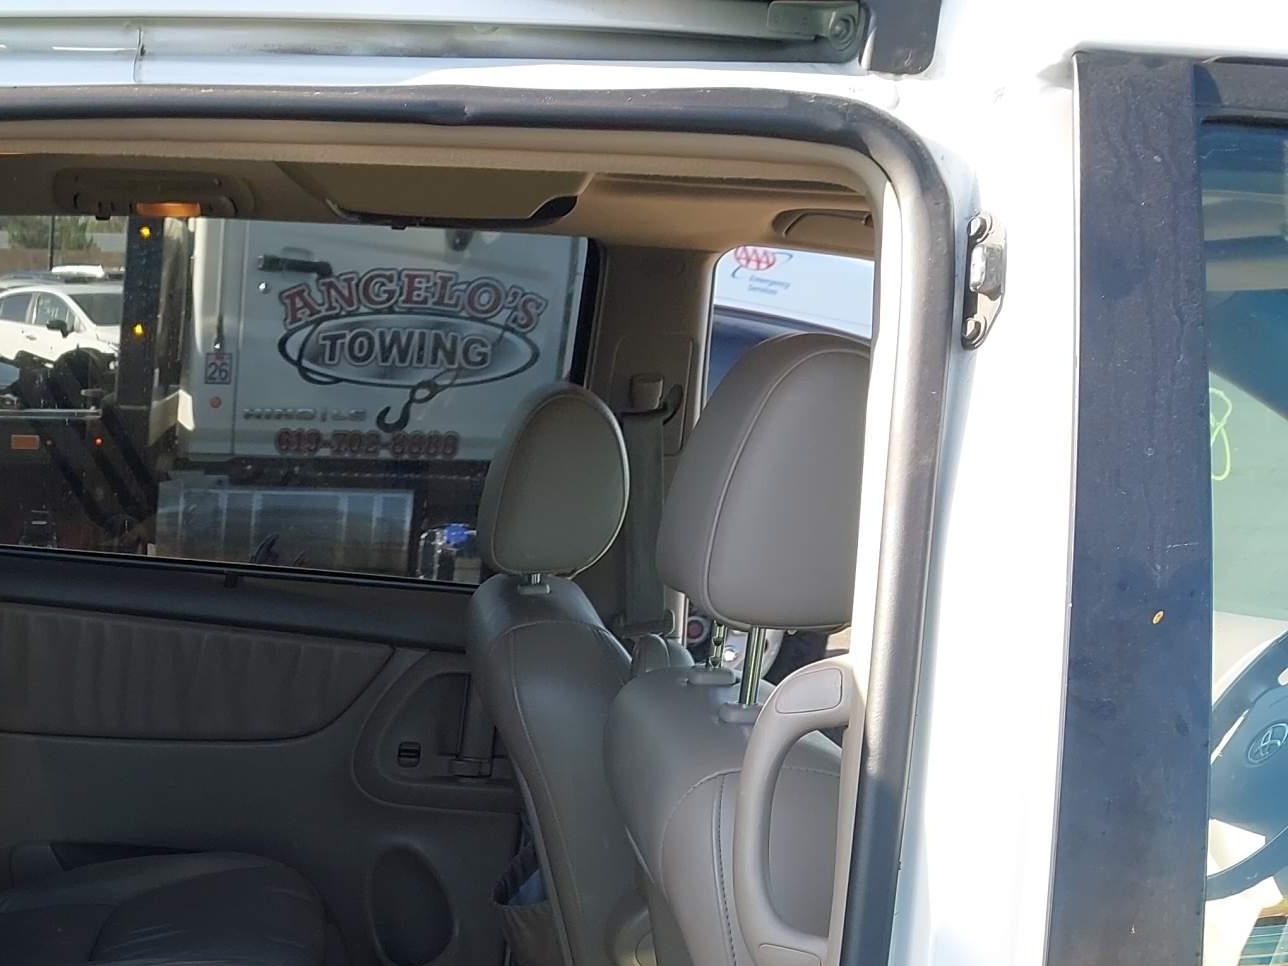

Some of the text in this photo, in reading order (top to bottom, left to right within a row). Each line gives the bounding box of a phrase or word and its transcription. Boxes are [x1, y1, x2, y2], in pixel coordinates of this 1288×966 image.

[279, 268, 549, 332] ANGELO'S
[319, 328, 494, 369] TOWING
[207, 361, 229, 381] 26
